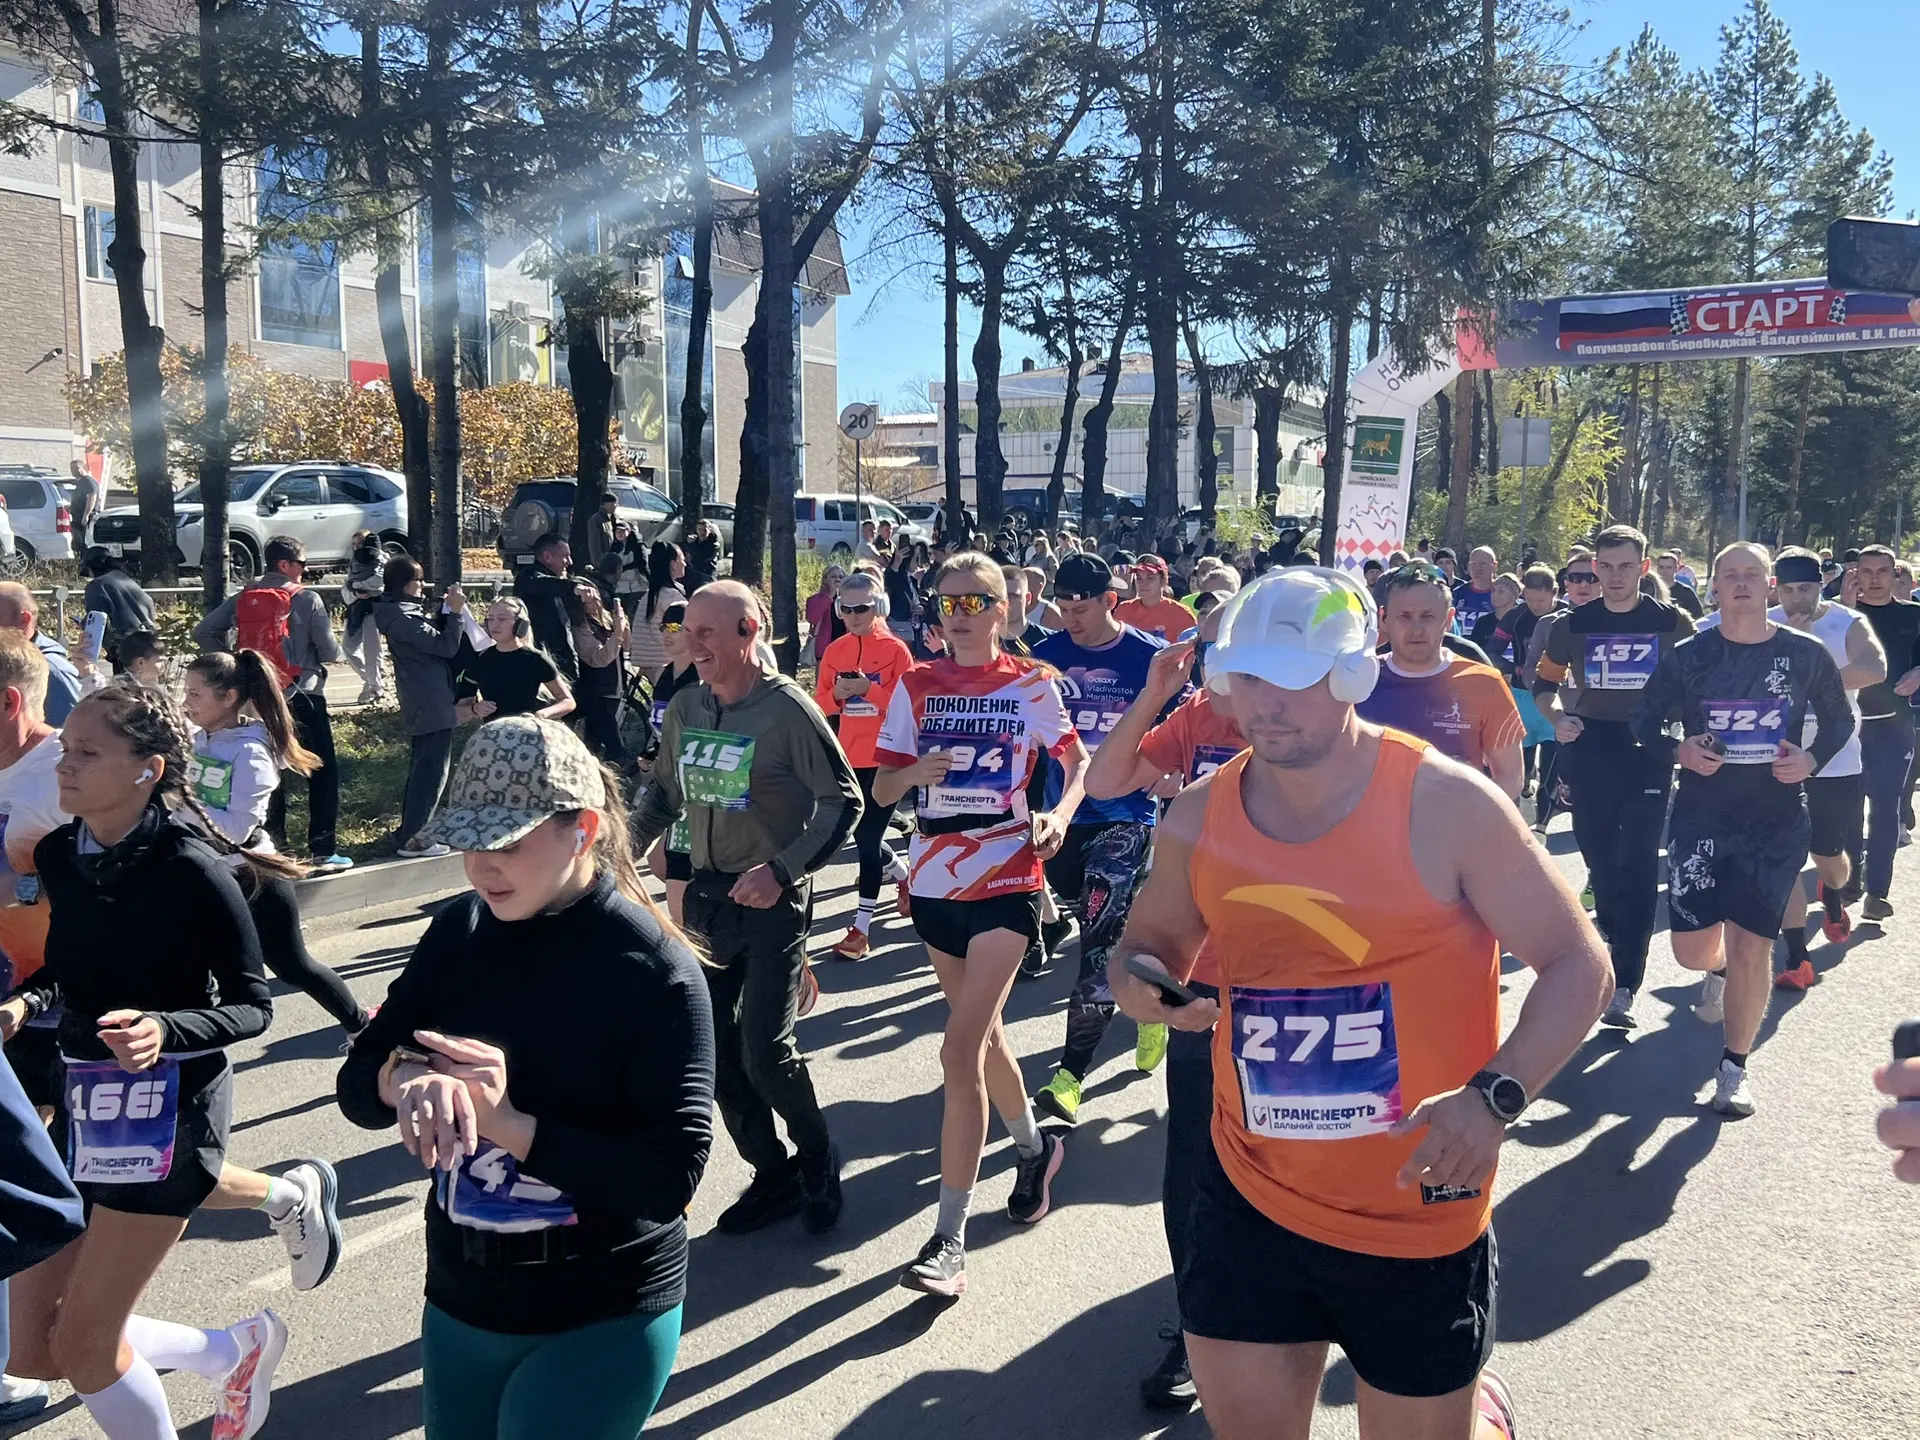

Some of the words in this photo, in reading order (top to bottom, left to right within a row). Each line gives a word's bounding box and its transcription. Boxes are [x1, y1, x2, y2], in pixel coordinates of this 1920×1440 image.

[1696, 295, 1824, 331] СТАРТ
[1577, 341, 1665, 355] Полумарафон
[1862, 328, 1886, 340] В.И.
[848, 413, 868, 429] 20
[1457, 611, 1489, 621] 34
[1591, 644, 1652, 661] 137
[1088, 675, 1118, 686] Galaxy
[1086, 693, 1125, 702] Marathon
[1087, 684, 1134, 695] Vladivostok
[926, 697, 1020, 716] ПОКОЛЕНИЕ
[1067, 710, 1124, 733] 93
[1707, 710, 1782, 730] 324
[679, 740, 745, 772] 115
[941, 794, 996, 804] ТРАНСНЕФТЬ
[1241, 1010, 1384, 1062] 275
[71, 1081, 167, 1120] 166
[1272, 1105, 1376, 1121] ТРАНСНЕФТЬ
[1274, 1121, 1313, 1130] ДАЛЬНИЙ
[1316, 1121, 1352, 1130] ВОСТОК
